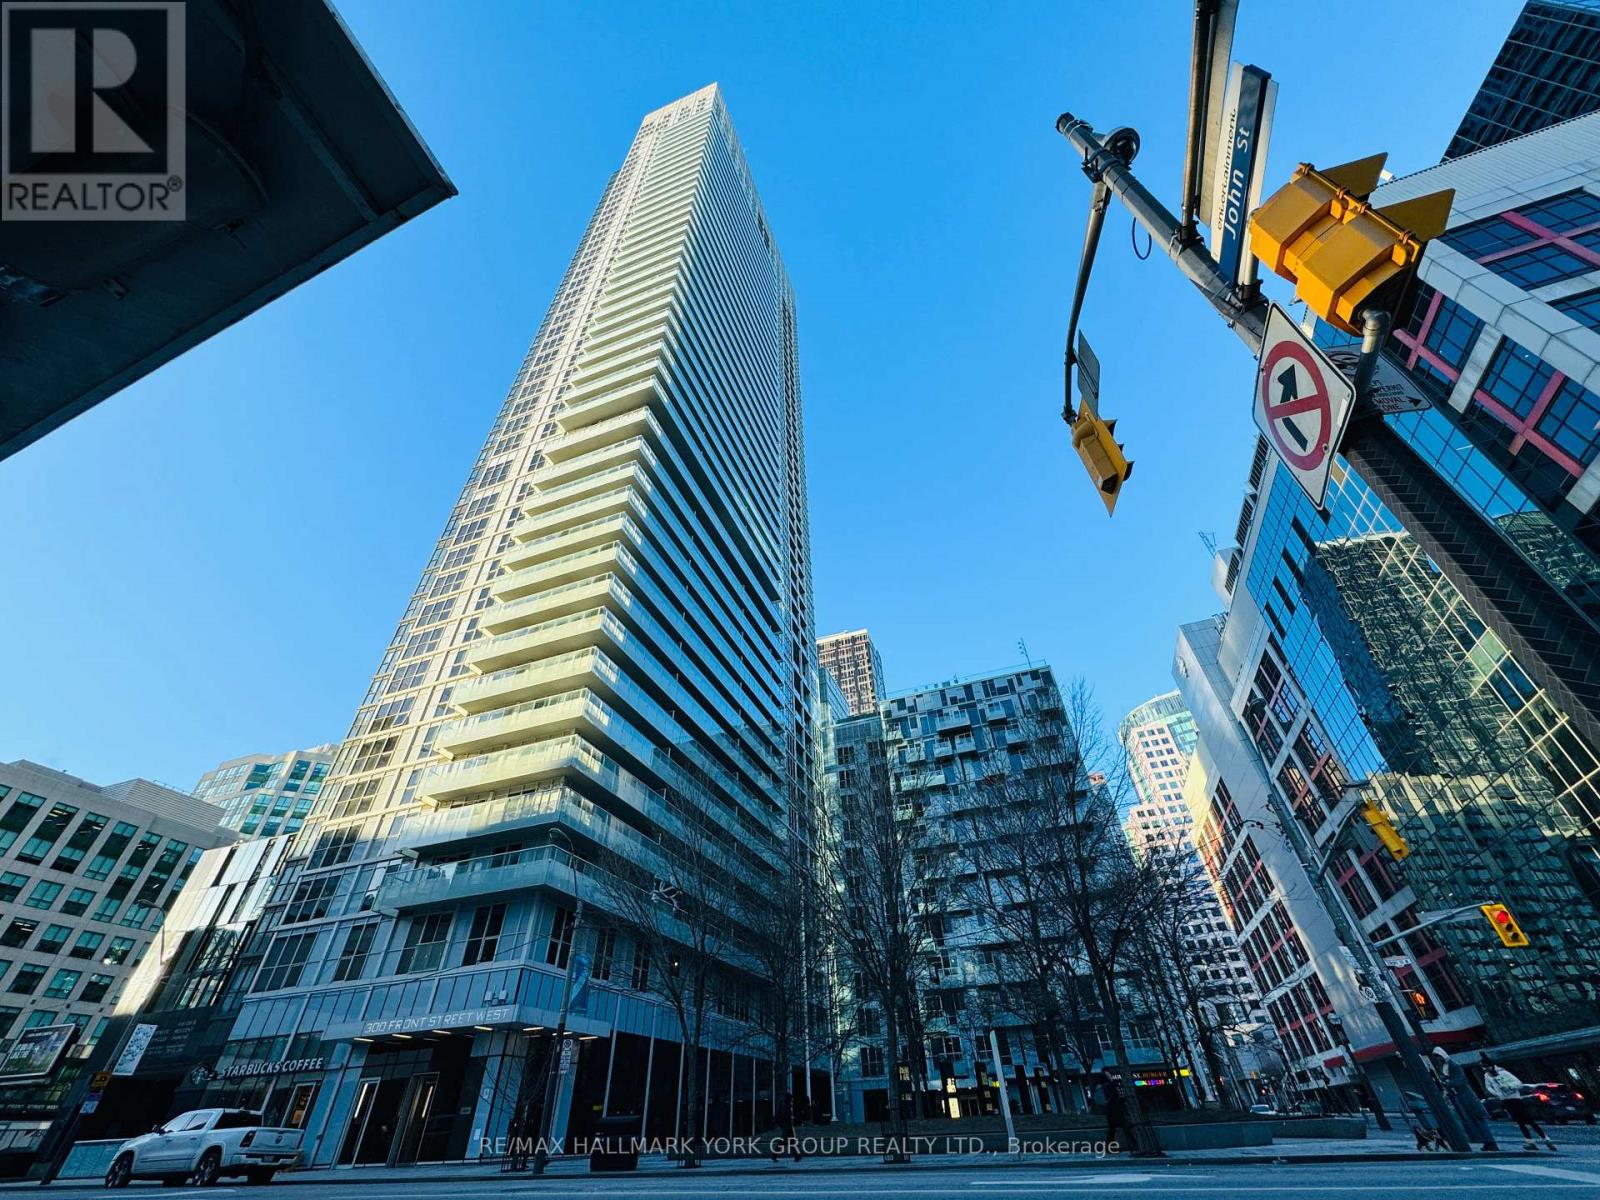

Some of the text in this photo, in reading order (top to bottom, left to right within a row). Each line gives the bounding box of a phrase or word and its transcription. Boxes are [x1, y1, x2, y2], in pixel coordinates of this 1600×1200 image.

[1224, 126, 1250, 240] John St
[364, 1007, 511, 1034] 300 FRONT STREET WEST
[222, 1057, 324, 1077] STARBUCKS COFFEE
